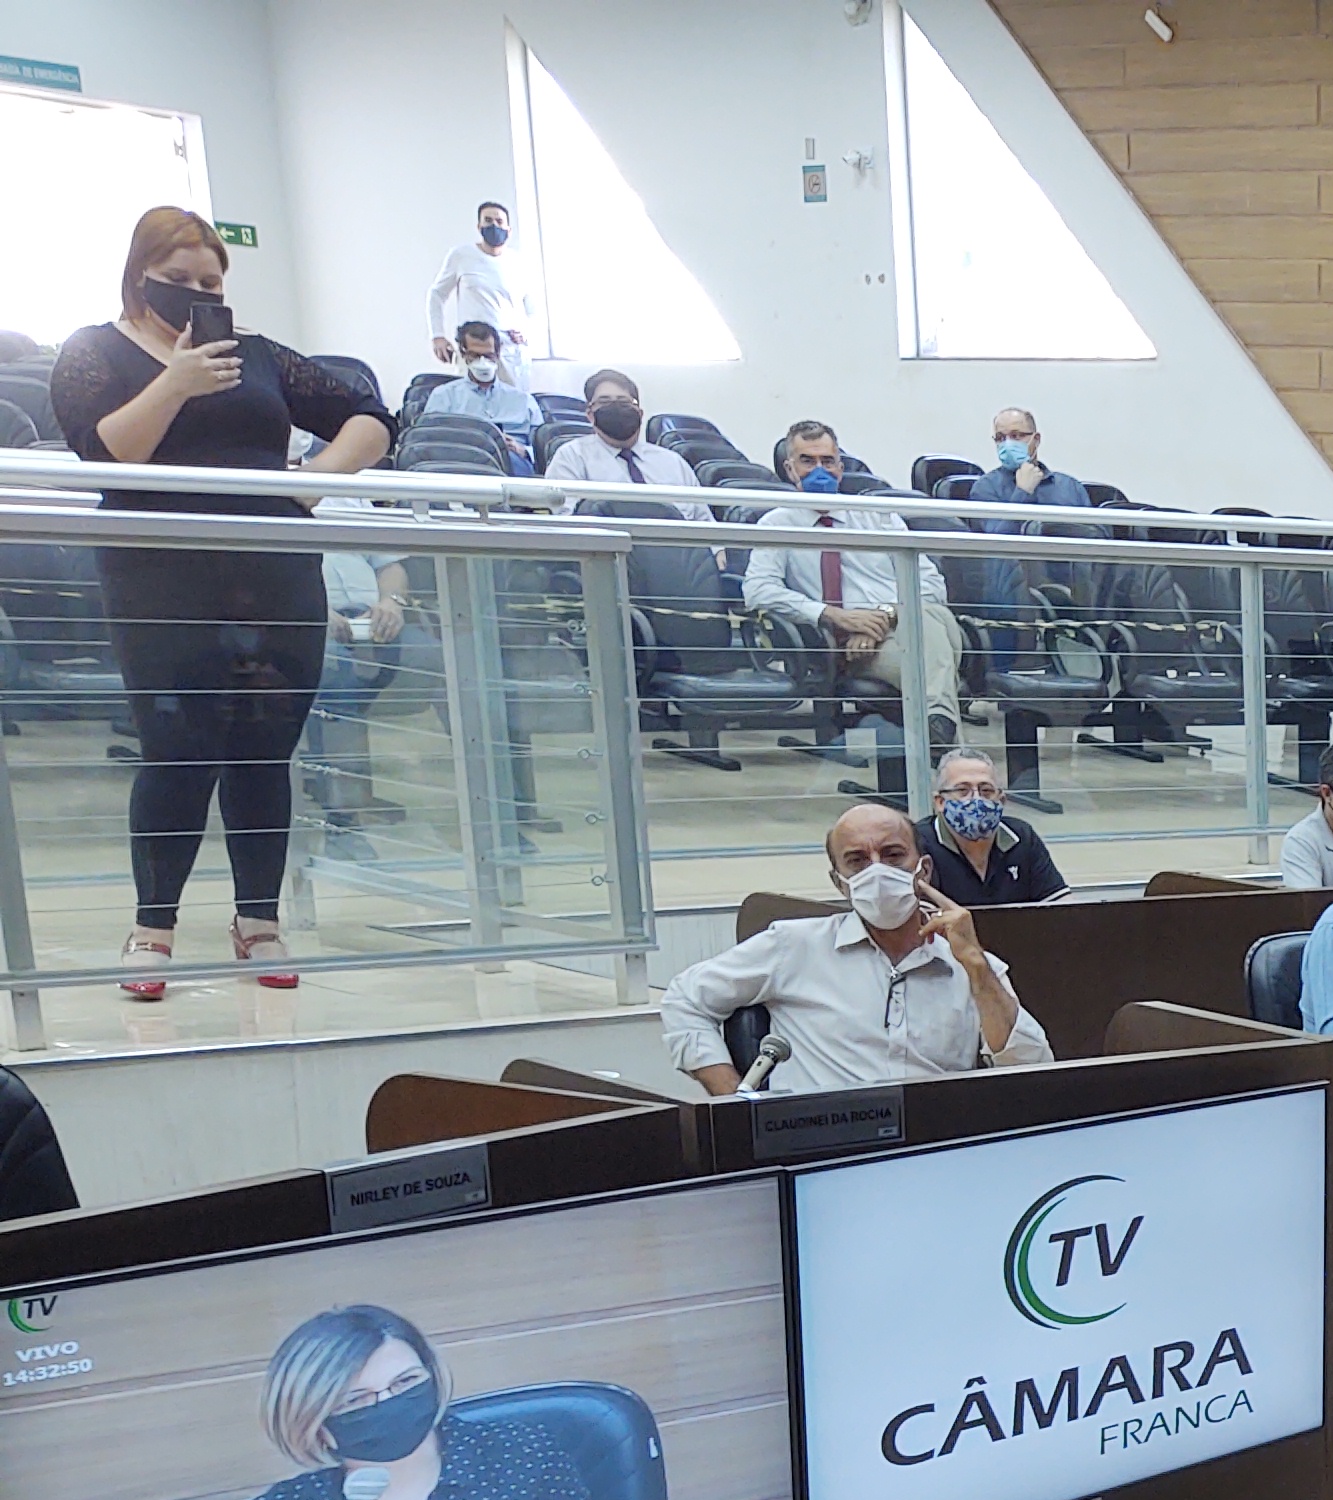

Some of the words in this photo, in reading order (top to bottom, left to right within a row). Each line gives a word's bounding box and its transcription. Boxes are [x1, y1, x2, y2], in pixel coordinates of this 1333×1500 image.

[765, 1116, 829, 1132] CLAUDINEI
[831, 1113, 848, 1125] DA
[851, 1107, 892, 1122] ROCHA
[350, 1185, 400, 1206] NIRLEY
[403, 1181, 422, 1196] DE
[425, 1172, 472, 1191] SOUZA
[1047, 1215, 1145, 1287] TV
[23, 1294, 58, 1319] TV
[15, 1341, 79, 1363] VIVO
[3, 1358, 93, 1387] 14:32:50
[880, 1326, 1255, 1466] CÂMARA
[1098, 1389, 1255, 1456] FRANCA
